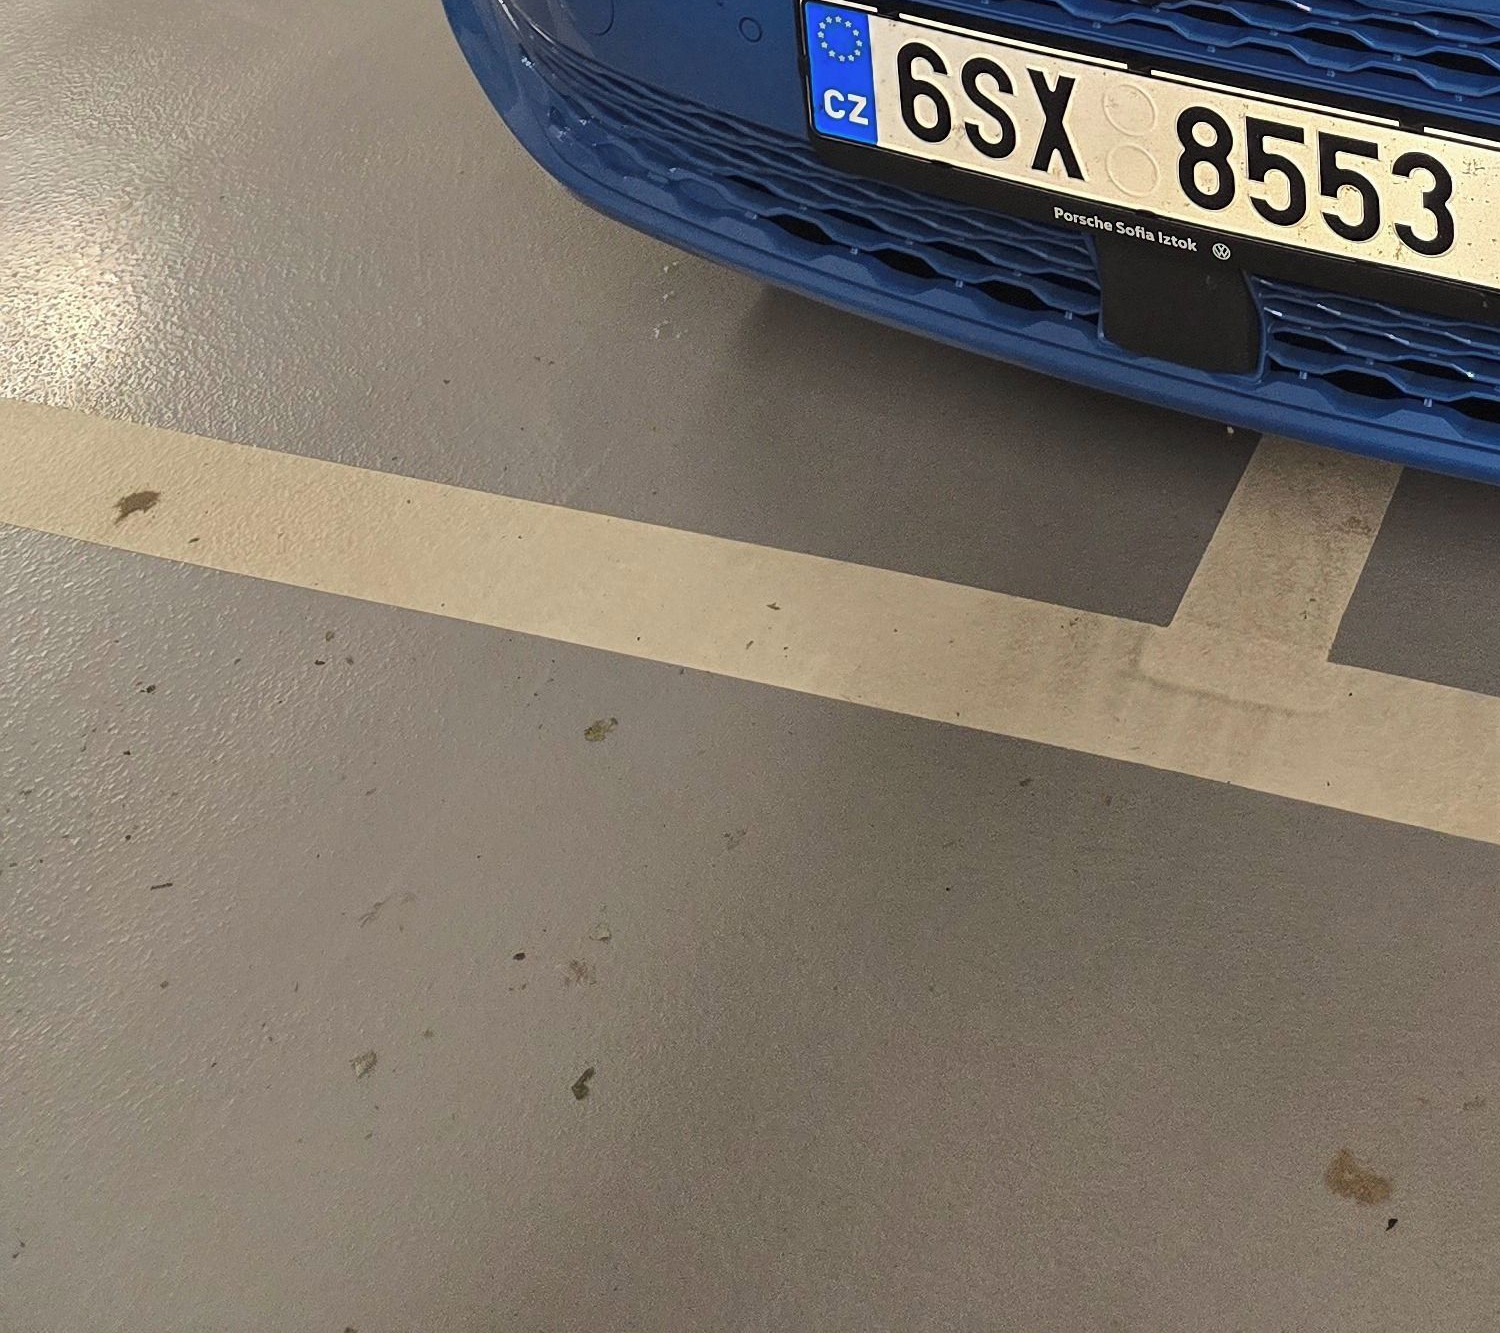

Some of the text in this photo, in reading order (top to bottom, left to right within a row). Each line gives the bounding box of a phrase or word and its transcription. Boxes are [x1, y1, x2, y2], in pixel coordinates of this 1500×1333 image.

[822, 42, 1456, 257] CZ 6SX 8553
[1053, 206, 1113, 232] Porsche
[1115, 221, 1155, 242] Sofia
[1158, 232, 1198, 252] Iztok
